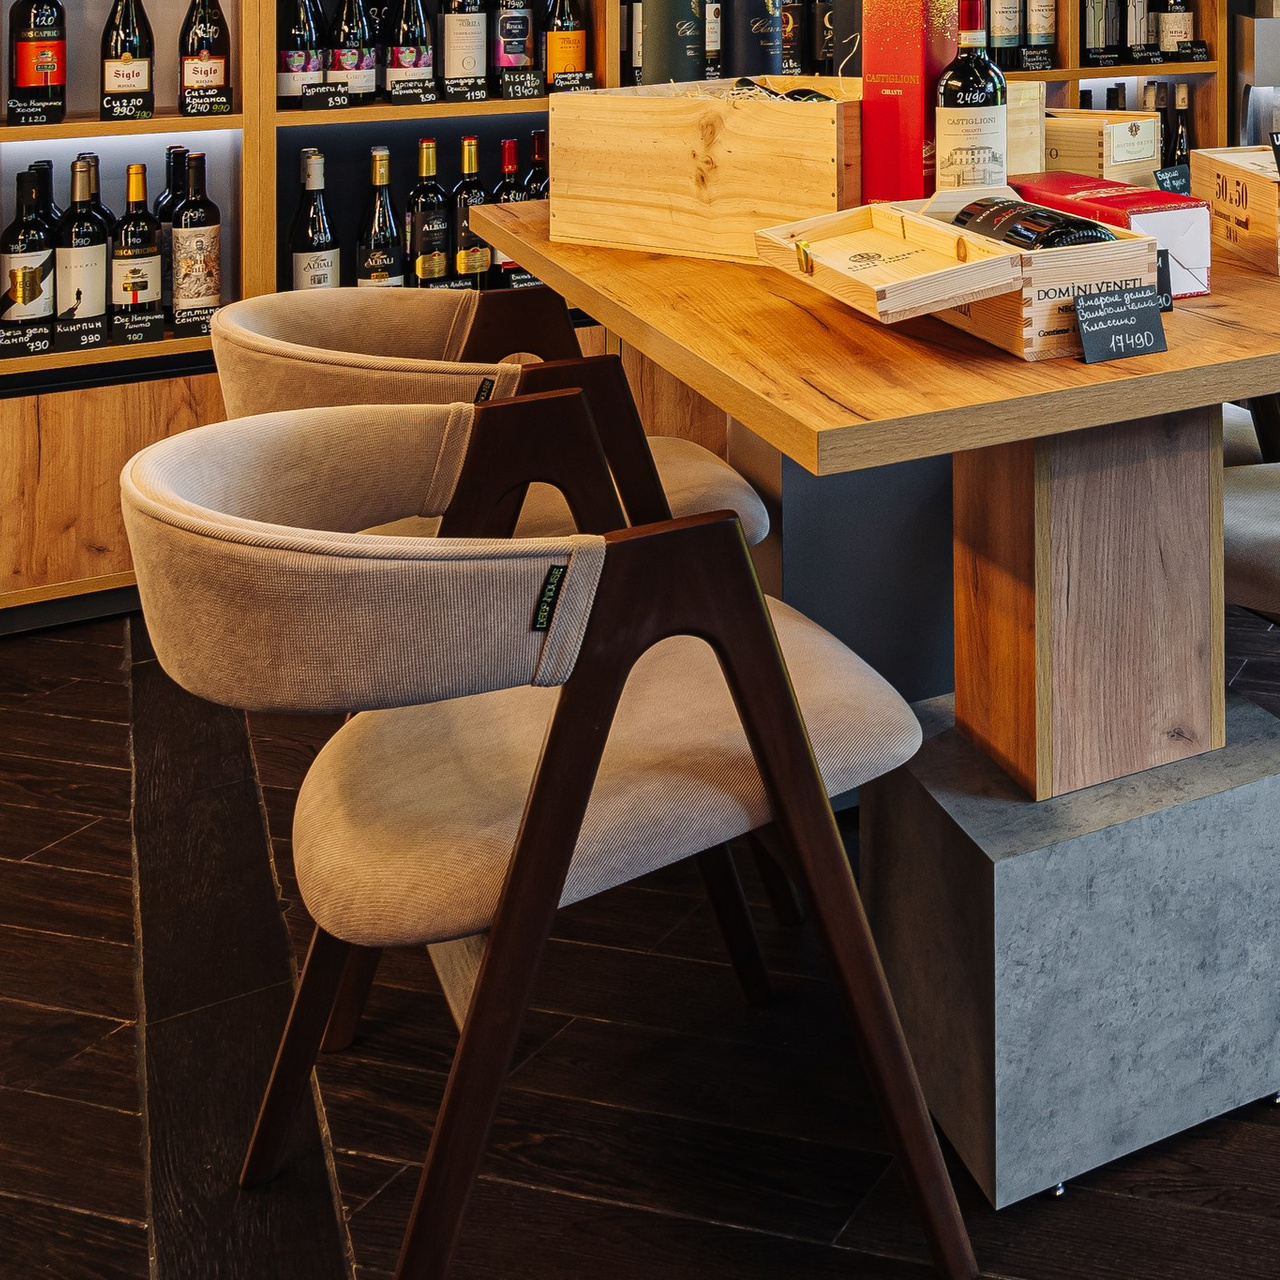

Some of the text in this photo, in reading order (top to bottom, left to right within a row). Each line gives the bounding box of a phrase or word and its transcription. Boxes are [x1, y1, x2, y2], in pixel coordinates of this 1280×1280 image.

[113, 69, 141, 81] Siglo
[192, 66, 218, 78] Siglo
[504, 74, 536, 82] RISCAL
[865, 73, 920, 85] CASTIGLIONI
[947, 117, 996, 125] CASTIGLIONI
[1216, 173, 1248, 210] 50 50
[1038, 328, 1070, 337] Contiene
[1110, 331, 1154, 352] 17490
